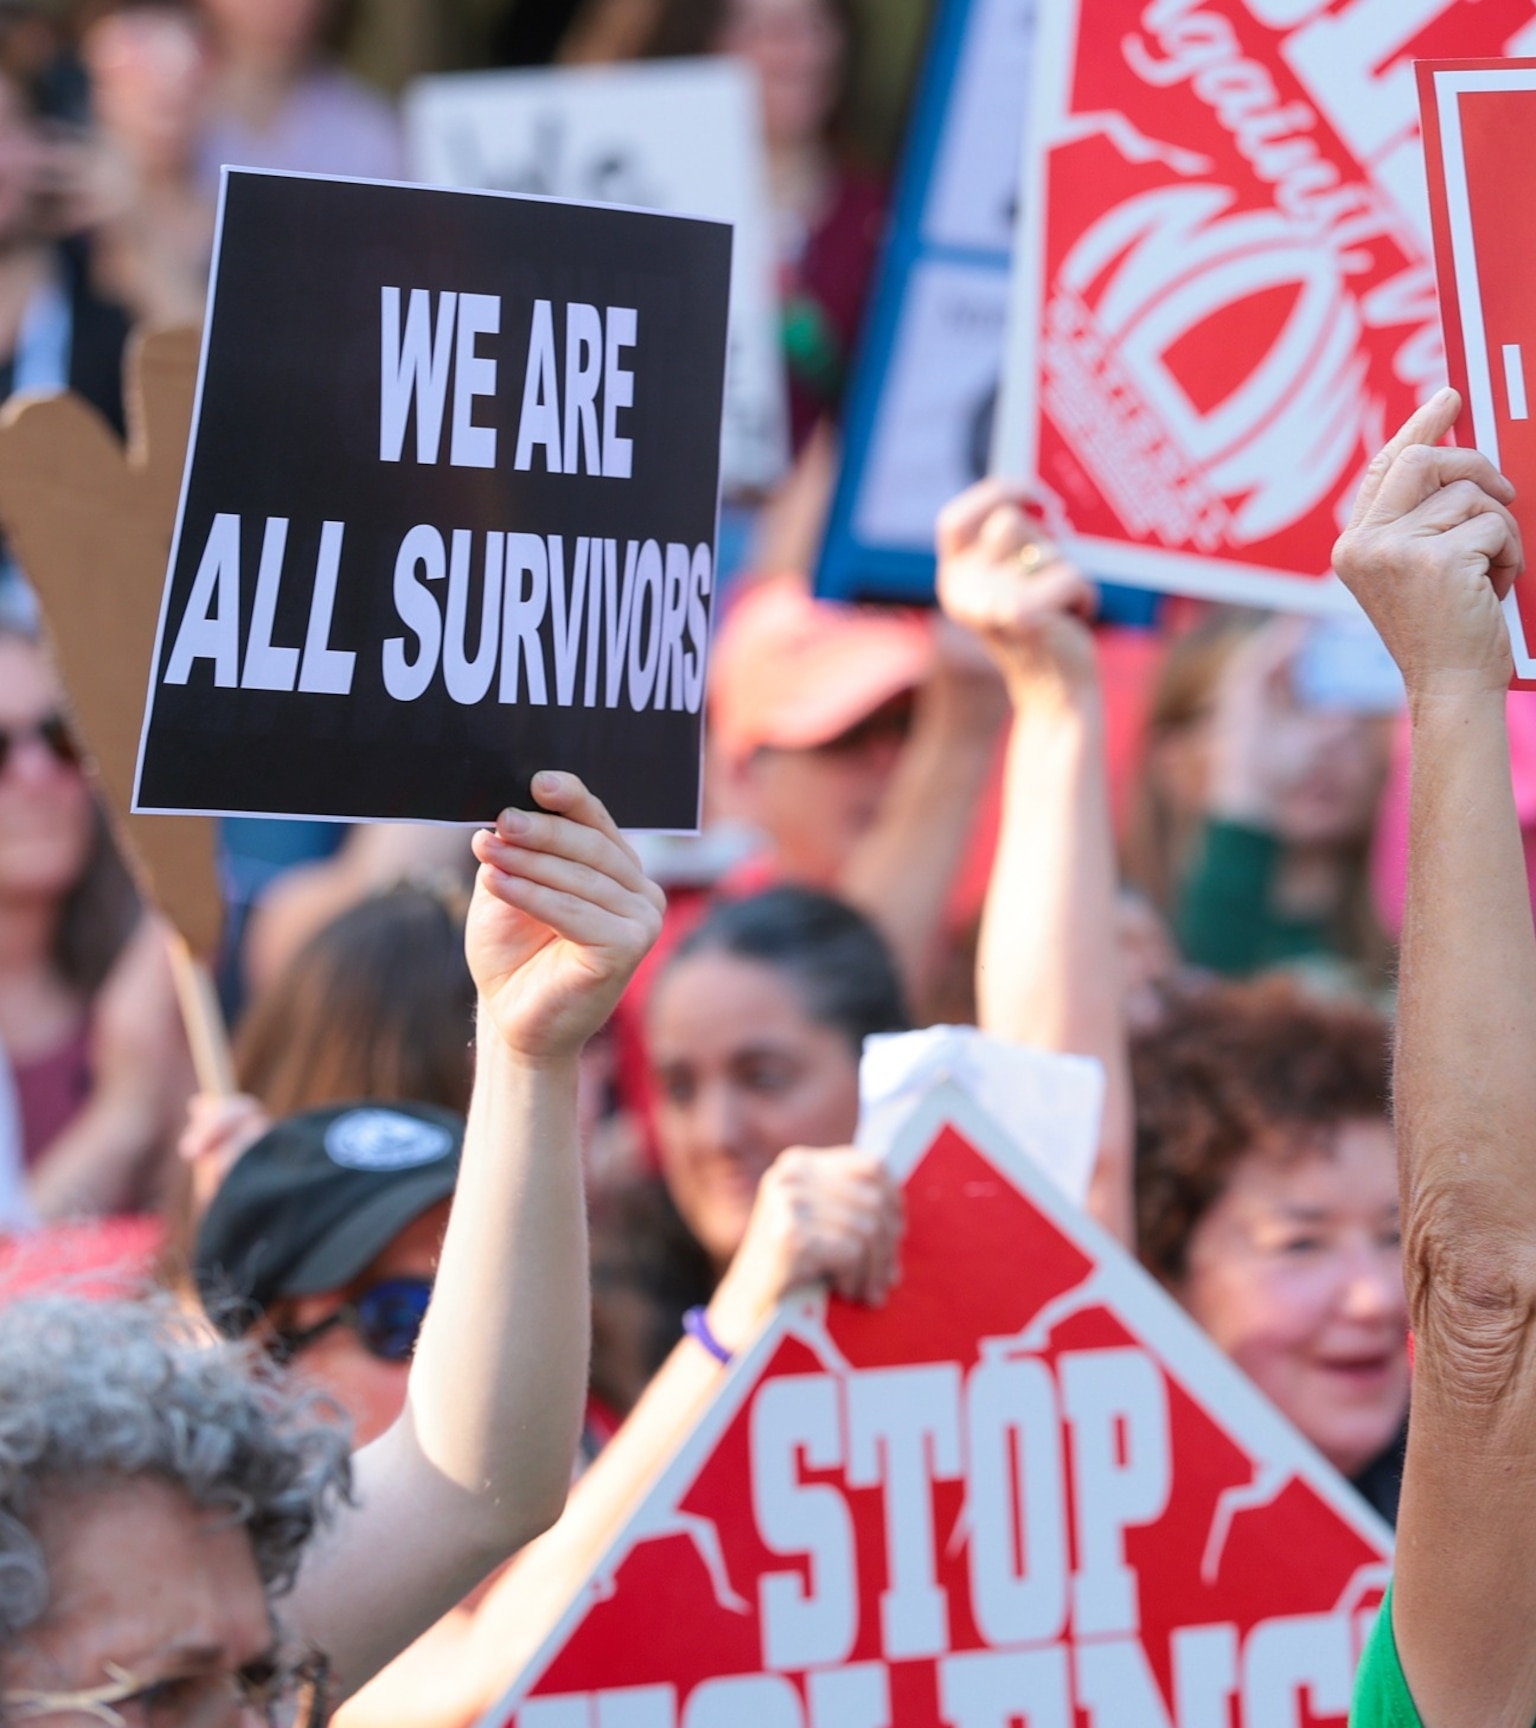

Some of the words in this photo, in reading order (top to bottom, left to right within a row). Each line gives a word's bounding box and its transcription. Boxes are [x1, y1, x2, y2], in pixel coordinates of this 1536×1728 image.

[379, 285, 501, 469] WE
[514, 299, 638, 478] ARE
[1501, 344, 1528, 420] I
[163, 513, 355, 695] ALL
[381, 523, 710, 714] SURVIVORS
[749, 1345, 1170, 1673] STOP
